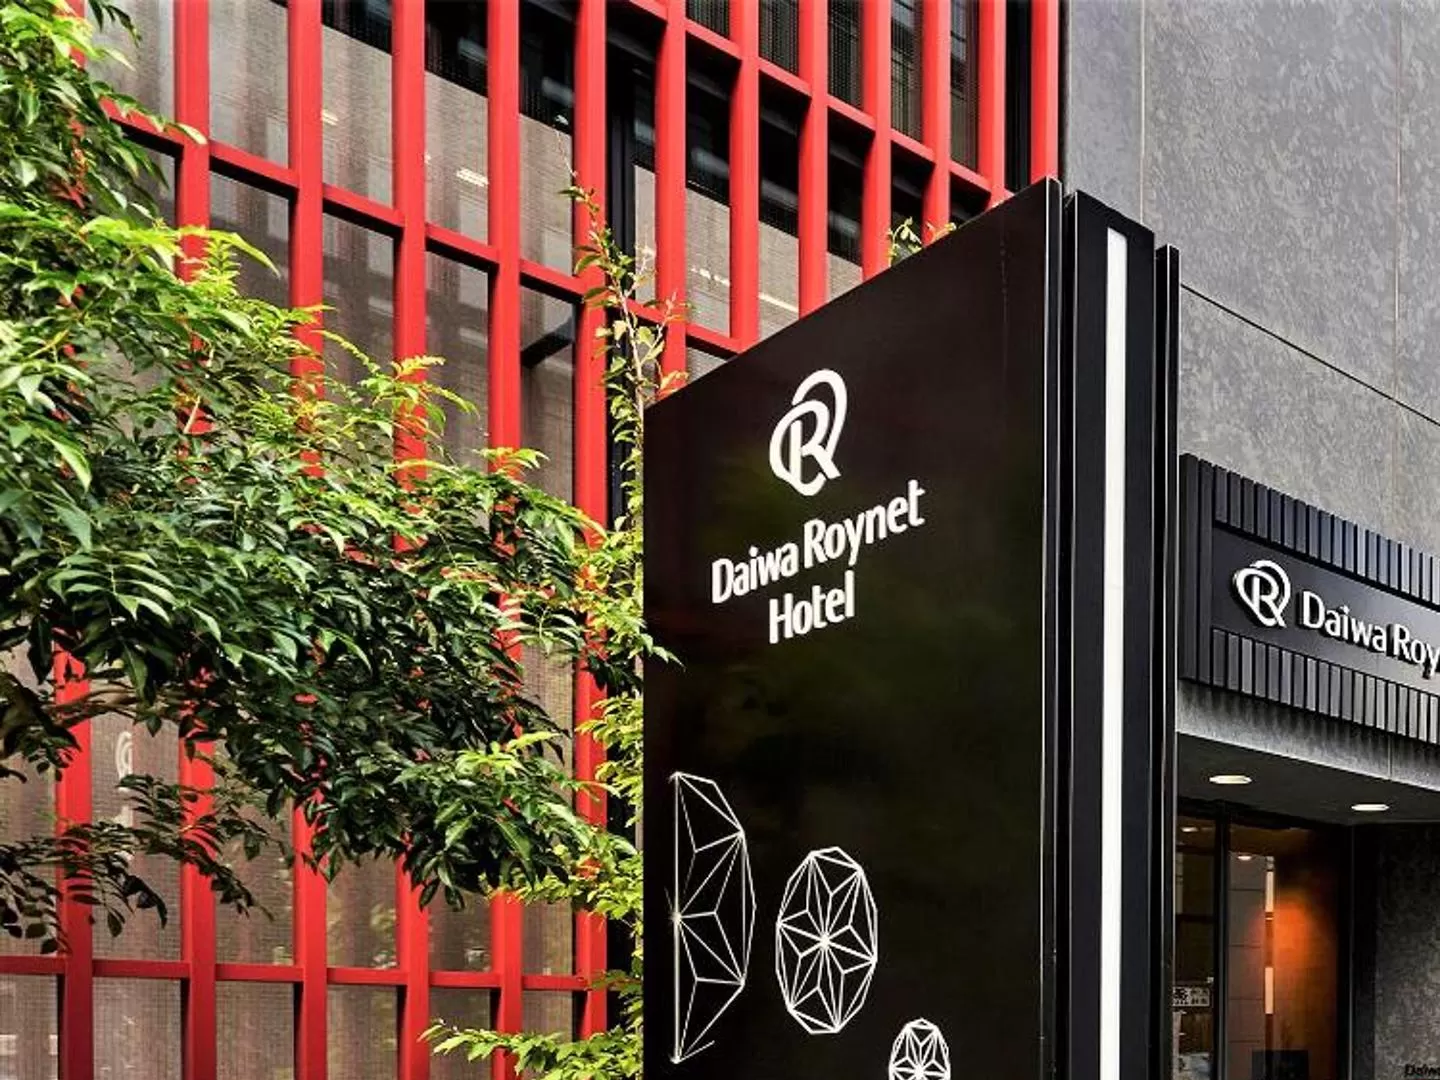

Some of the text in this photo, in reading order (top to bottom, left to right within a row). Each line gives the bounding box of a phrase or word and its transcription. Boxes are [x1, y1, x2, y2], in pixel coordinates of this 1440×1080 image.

[711, 479, 925, 604] Daiwa Roynet
[769, 569, 855, 643] Hotel
[1301, 590, 1388, 653] Daiwa
